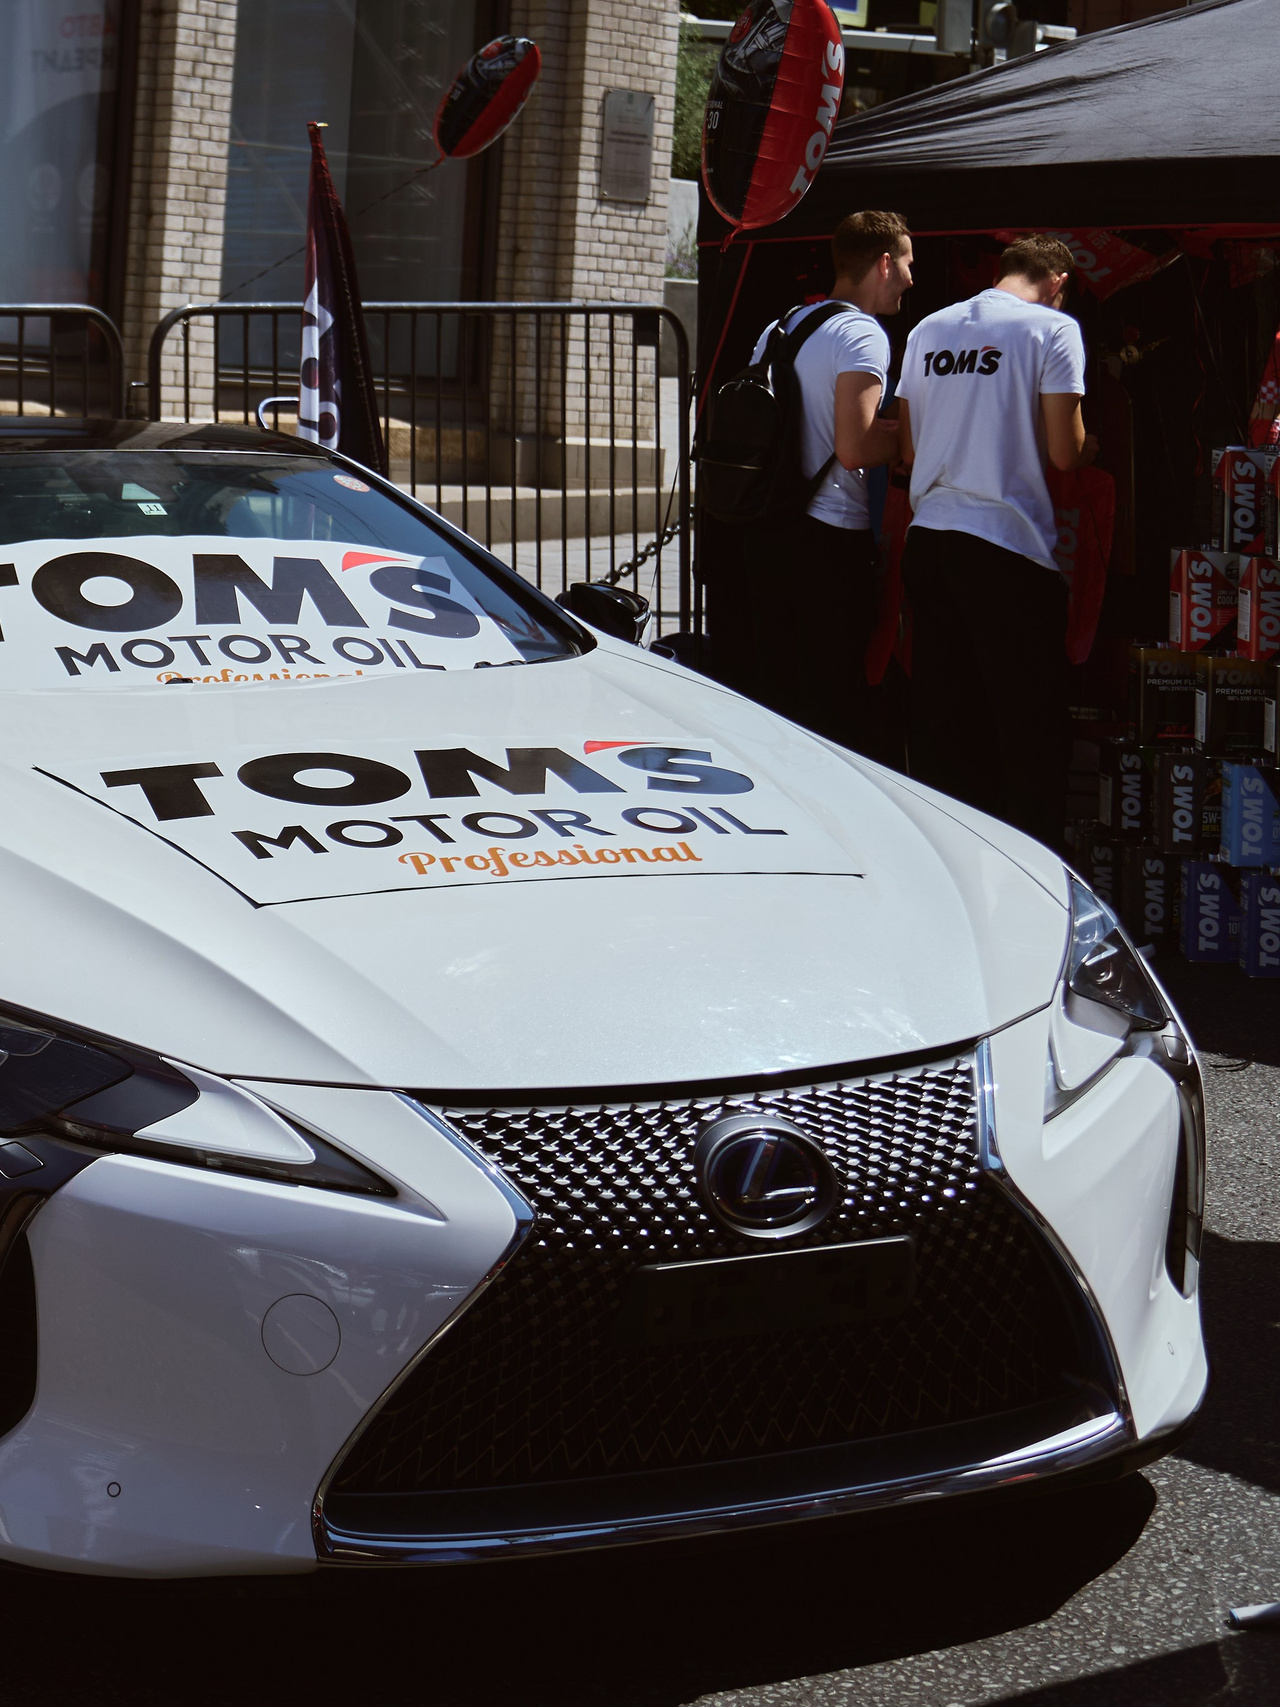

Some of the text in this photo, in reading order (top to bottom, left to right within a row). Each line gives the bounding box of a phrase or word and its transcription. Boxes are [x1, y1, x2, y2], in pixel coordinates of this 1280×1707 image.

[789, 40, 846, 195] TOM'S
[923, 345, 1003, 378] TOM'S
[1232, 460, 1257, 544] TOM'S
[1188, 559, 1213, 643] TOM'S
[1257, 567, 1280, 652] TOM'S
[54, 634, 447, 676] MOTOR OIL
[1147, 678, 1183, 687] PREMIUM
[1215, 687, 1252, 697] PREMIUM
[100, 740, 754, 822] TOM'S
[1120, 753, 1143, 831] TOM'S
[1170, 763, 1194, 843] TOM'S
[1240, 776, 1265, 857] TOM'S
[230, 806, 788, 860] MOTOR OIL
[397, 840, 703, 878] Professional
[1142, 858, 1166, 936] TOM'S
[1197, 872, 1221, 951] TOM'S
[1257, 886, 1280, 968] TOM'S
